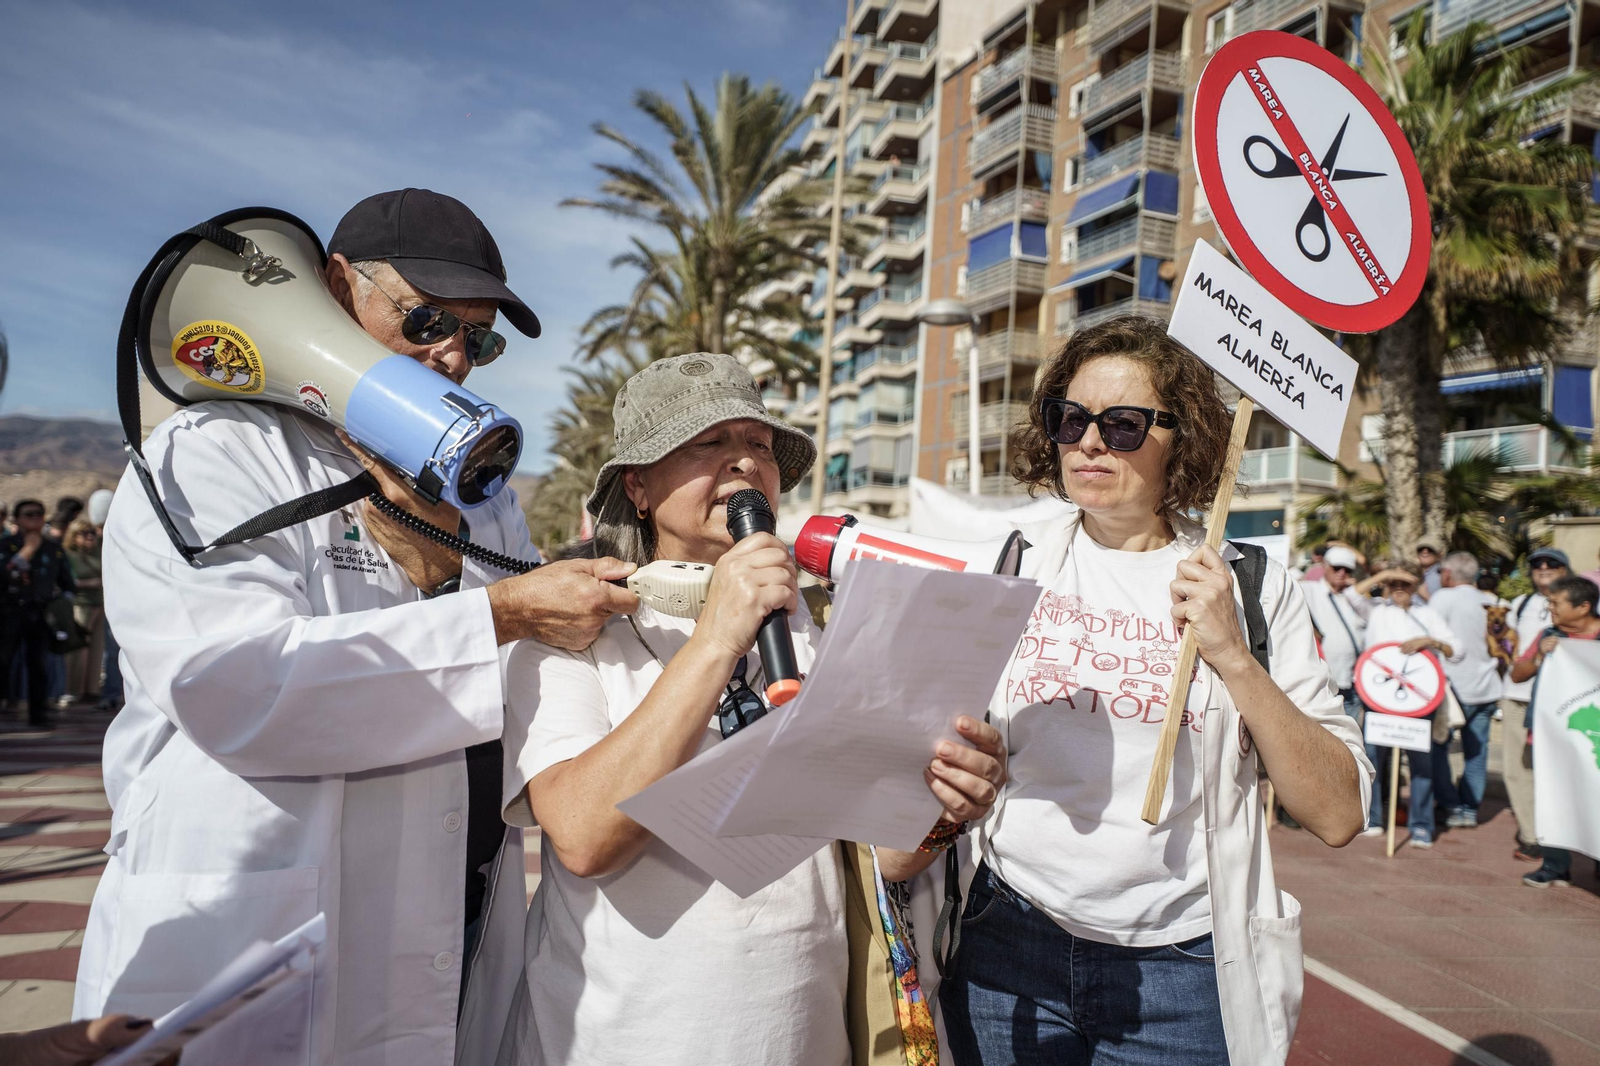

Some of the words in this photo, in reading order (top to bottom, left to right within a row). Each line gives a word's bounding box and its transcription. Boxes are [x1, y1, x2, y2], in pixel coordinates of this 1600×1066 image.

[1248, 67, 1283, 120] MAREA
[1299, 152, 1338, 211] BLANCA
[1345, 231, 1391, 297] ALMERÍA
[181, 324, 215, 342] Forestales
[1194, 272, 1263, 337] MAREA
[1270, 330, 1344, 401] BLANCA
[247, 350, 261, 372] Estatal
[1217, 333, 1307, 410] ALMERÍA
[346, 555, 357, 564] de
[358, 556, 366, 565] la
[367, 559, 389, 570] Salud
[364, 550, 374, 559] de
[1030, 605, 1107, 634] ANIDAD
[1020, 636, 1060, 661] DE
[1069, 640, 1196, 682] TOD@
[1006, 679, 1076, 710] PARA
